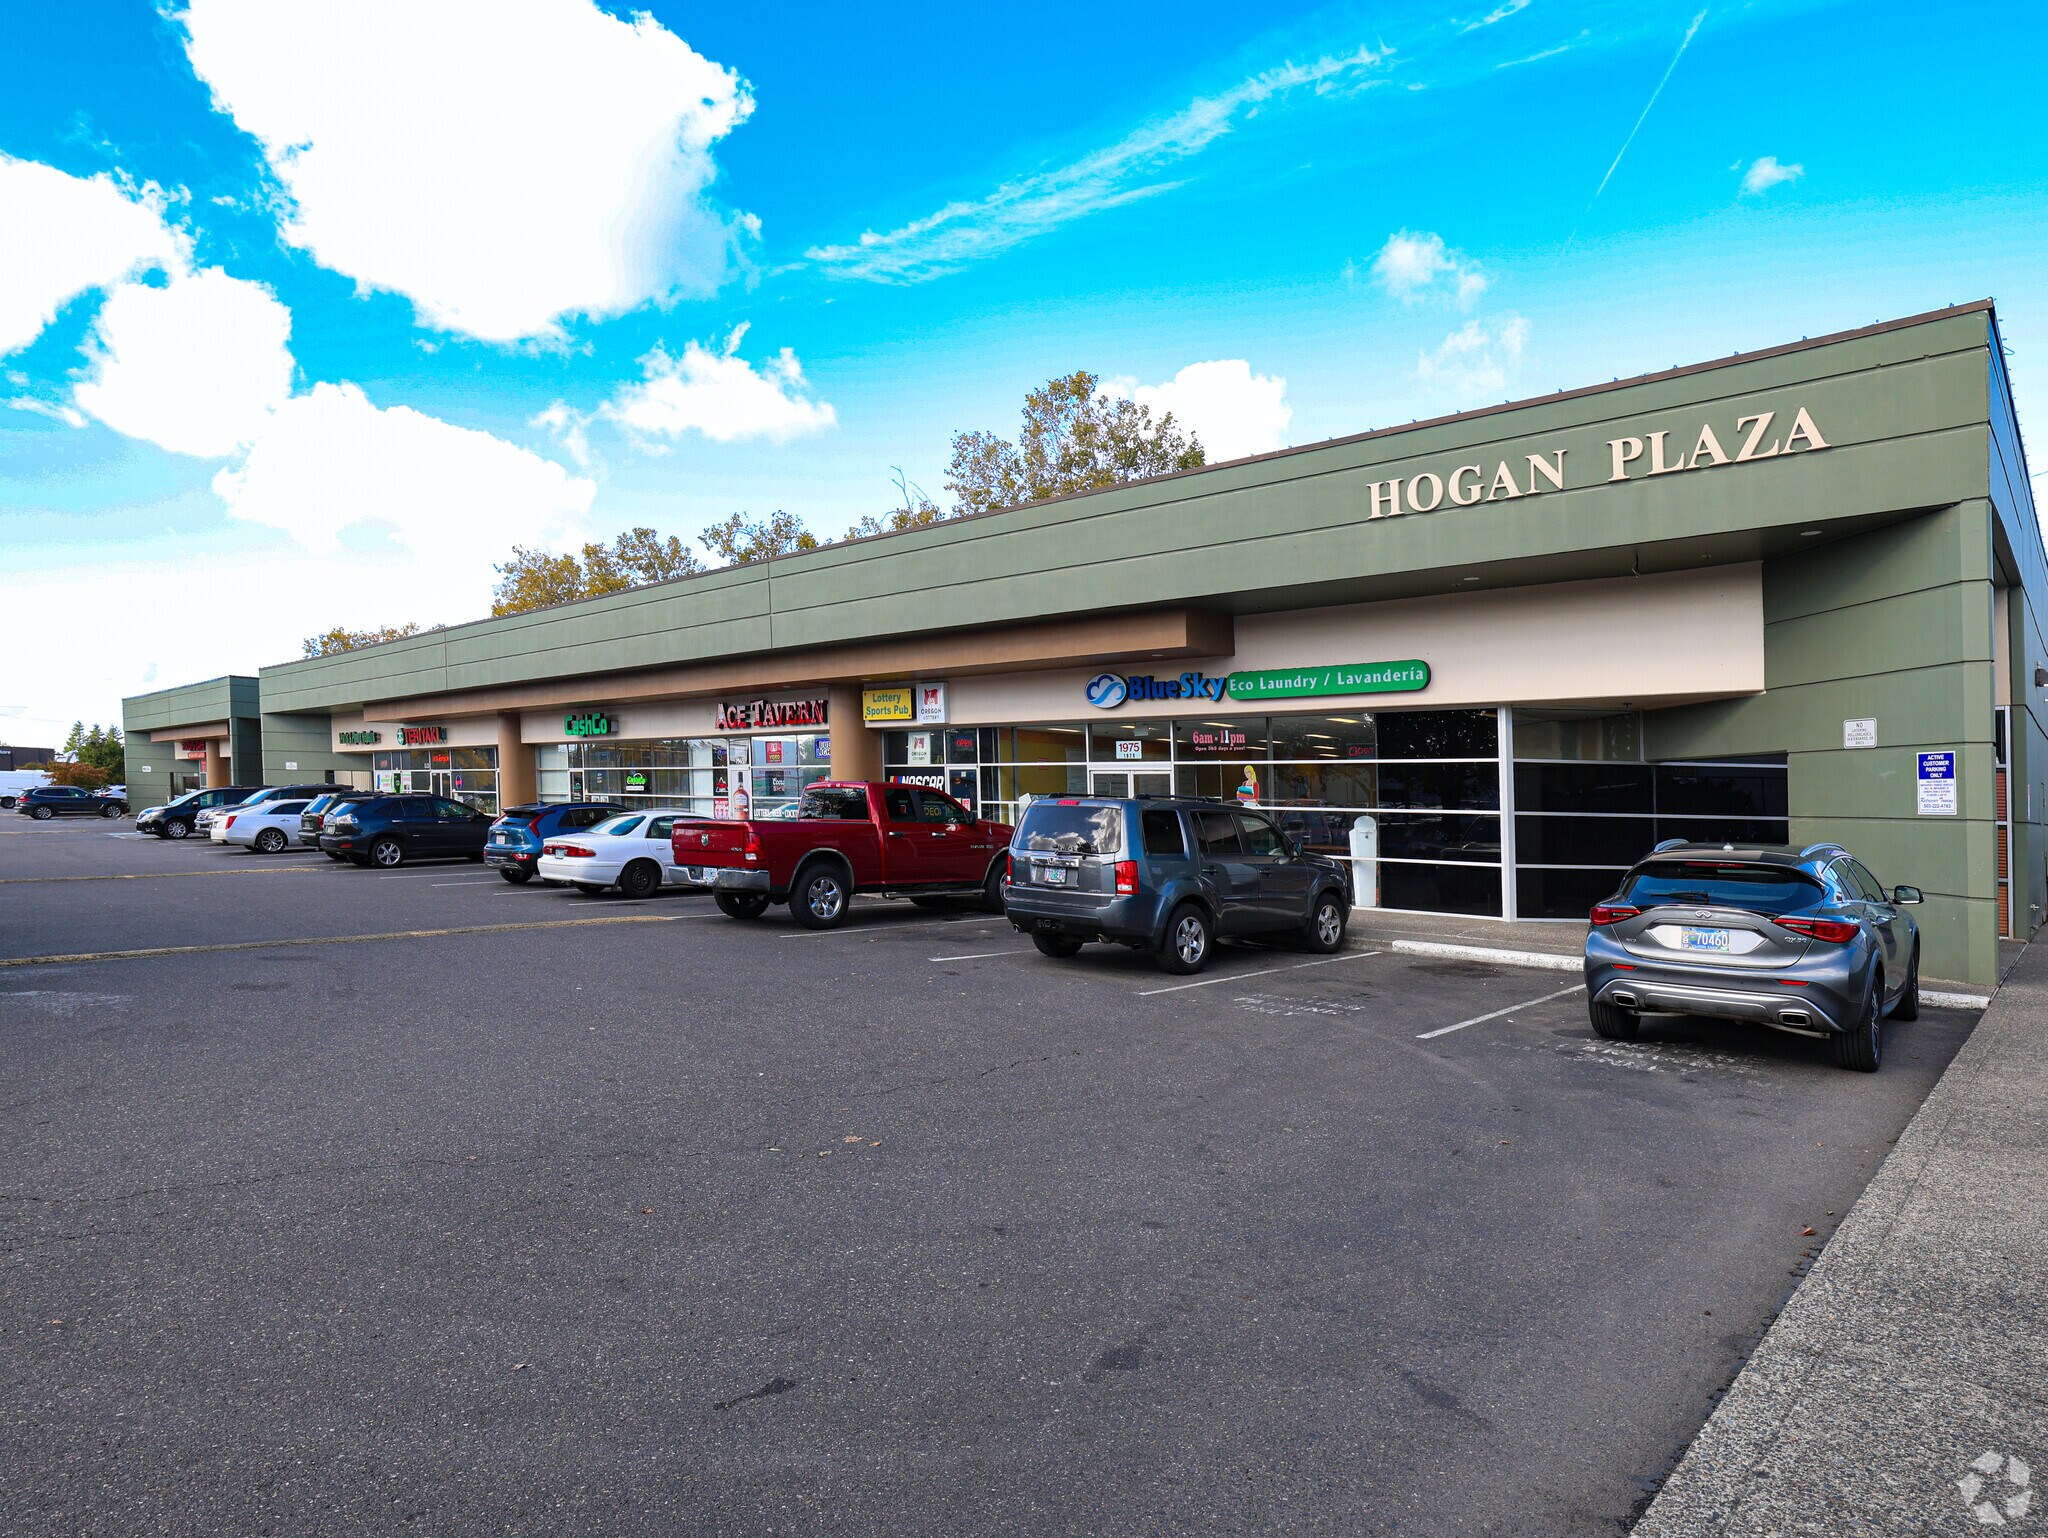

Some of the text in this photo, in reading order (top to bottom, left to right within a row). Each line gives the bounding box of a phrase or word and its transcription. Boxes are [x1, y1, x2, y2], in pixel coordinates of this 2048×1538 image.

[1366, 406, 1832, 521] HOGAN PLAZA
[1128, 672, 1226, 702] BlueSky
[1229, 678, 1254, 692] Eco
[1259, 675, 1317, 691] Laundry
[1337, 667, 1424, 686] Lavandería
[872, 692, 902, 704] Lottery
[865, 704, 909, 717] Sports Pub
[403, 726, 440, 745] TERIYAKI
[1192, 730, 1213, 744] 6am
[1220, 730, 1246, 747] 11pm
[957, 739, 974, 748] OPEN
[1118, 743, 1140, 752] 1975
[1348, 745, 1374, 757] Open
[1696, 932, 1728, 947] 70460
